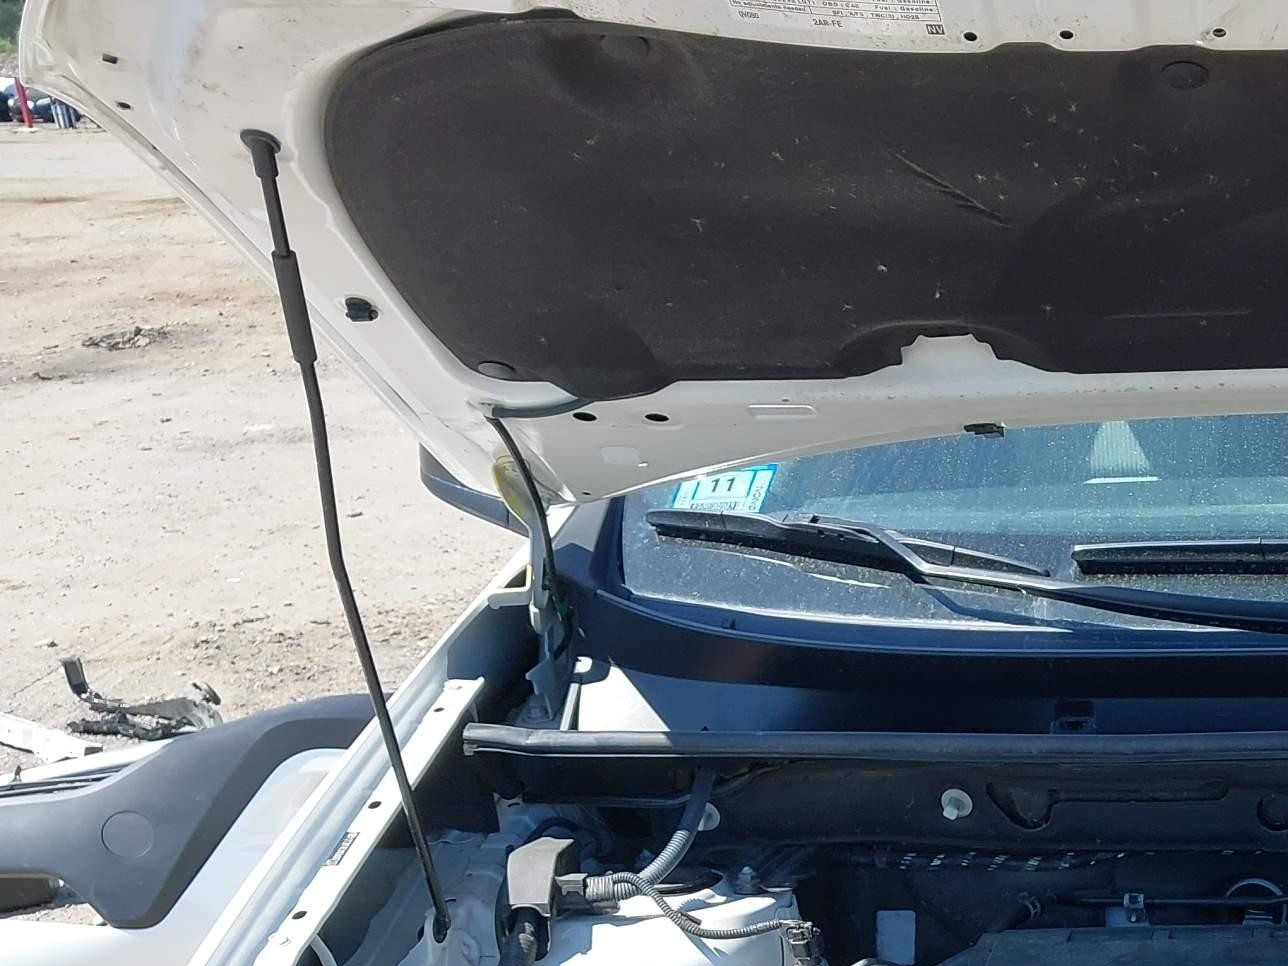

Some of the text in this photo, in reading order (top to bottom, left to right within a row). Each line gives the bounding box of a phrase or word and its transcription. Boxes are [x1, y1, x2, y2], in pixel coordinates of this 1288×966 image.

[812, 18, 844, 28] 2AR-FE
[926, 24, 945, 35] NV
[711, 477, 736, 493] 11
